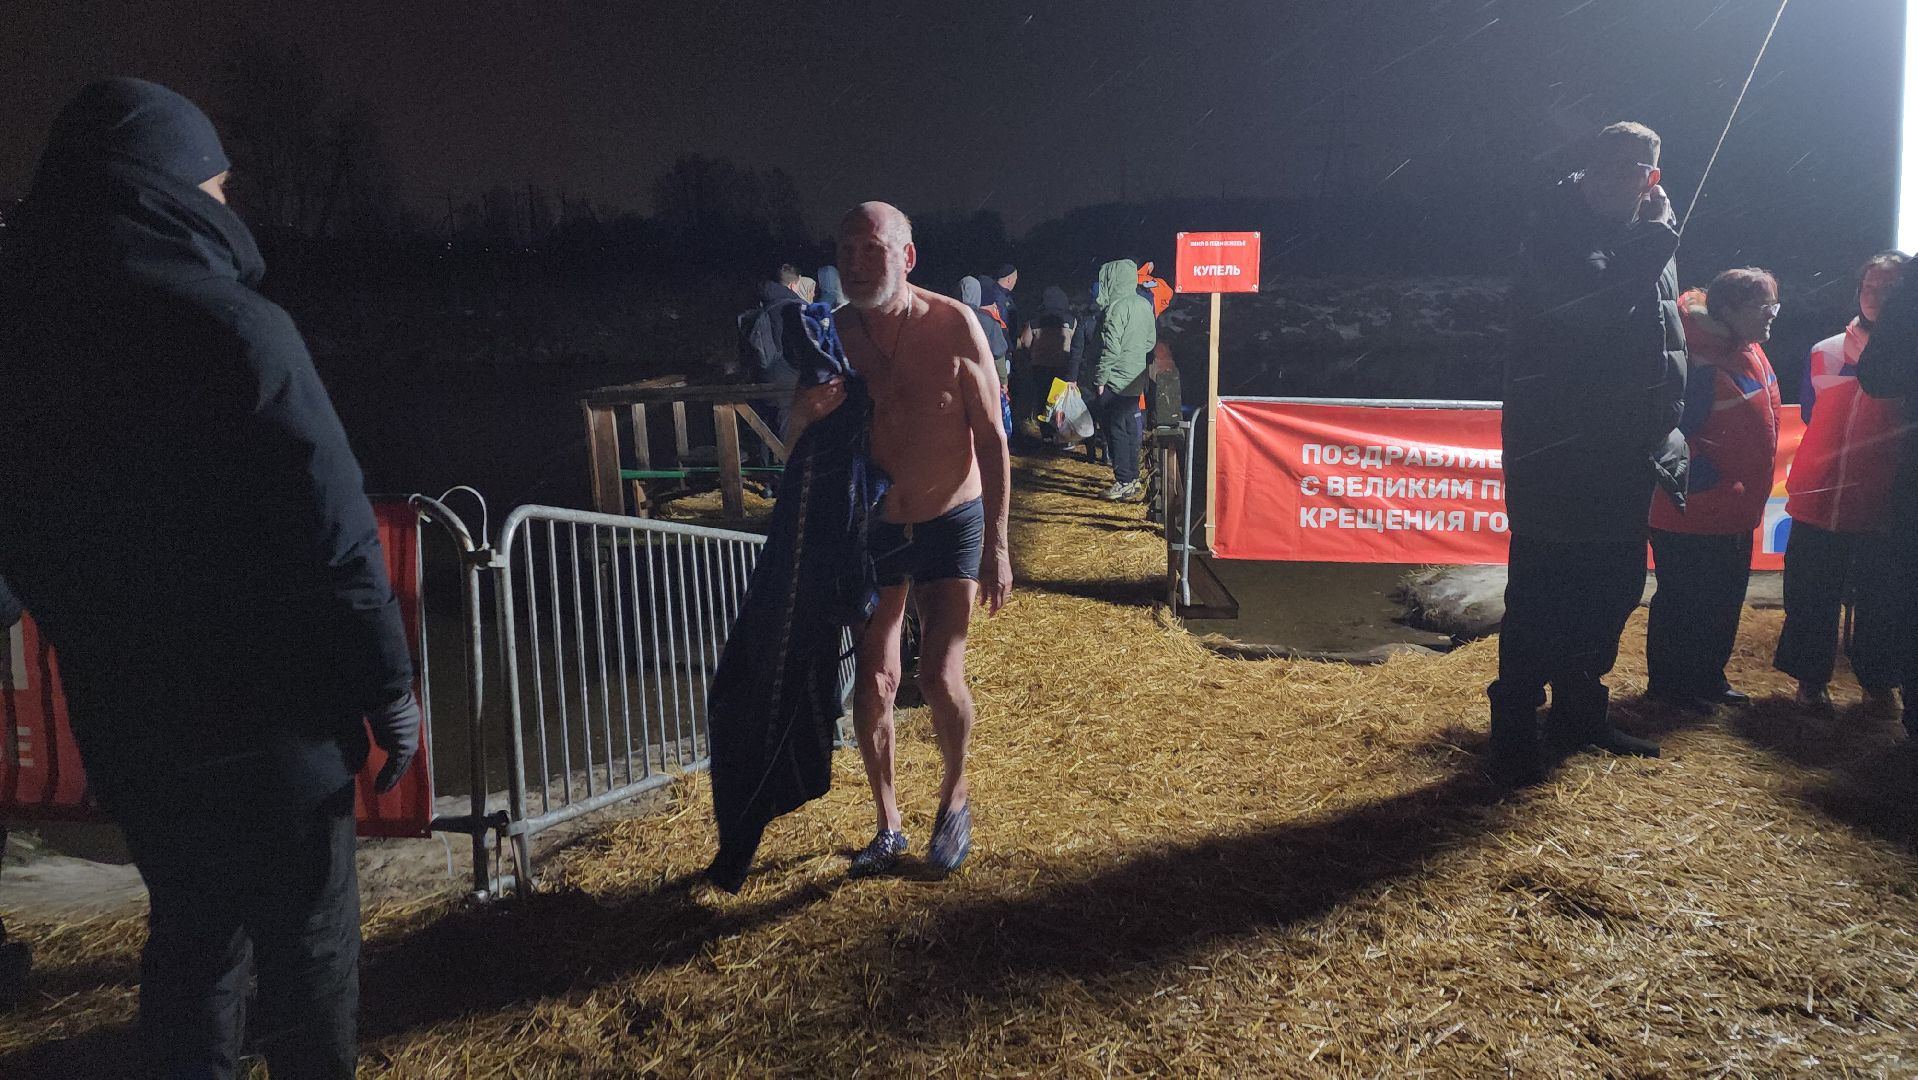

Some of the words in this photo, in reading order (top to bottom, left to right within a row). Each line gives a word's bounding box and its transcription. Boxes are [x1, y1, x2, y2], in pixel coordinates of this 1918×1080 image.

[1193, 265, 1241, 276] КУПЕЛЬ
[1300, 475, 1320, 496] С
[1326, 476, 1473, 500] ВЕЛИКИМ
[1480, 479, 1505, 500] П
[1300, 507, 1465, 533] КРЕЩЕНИЯ
